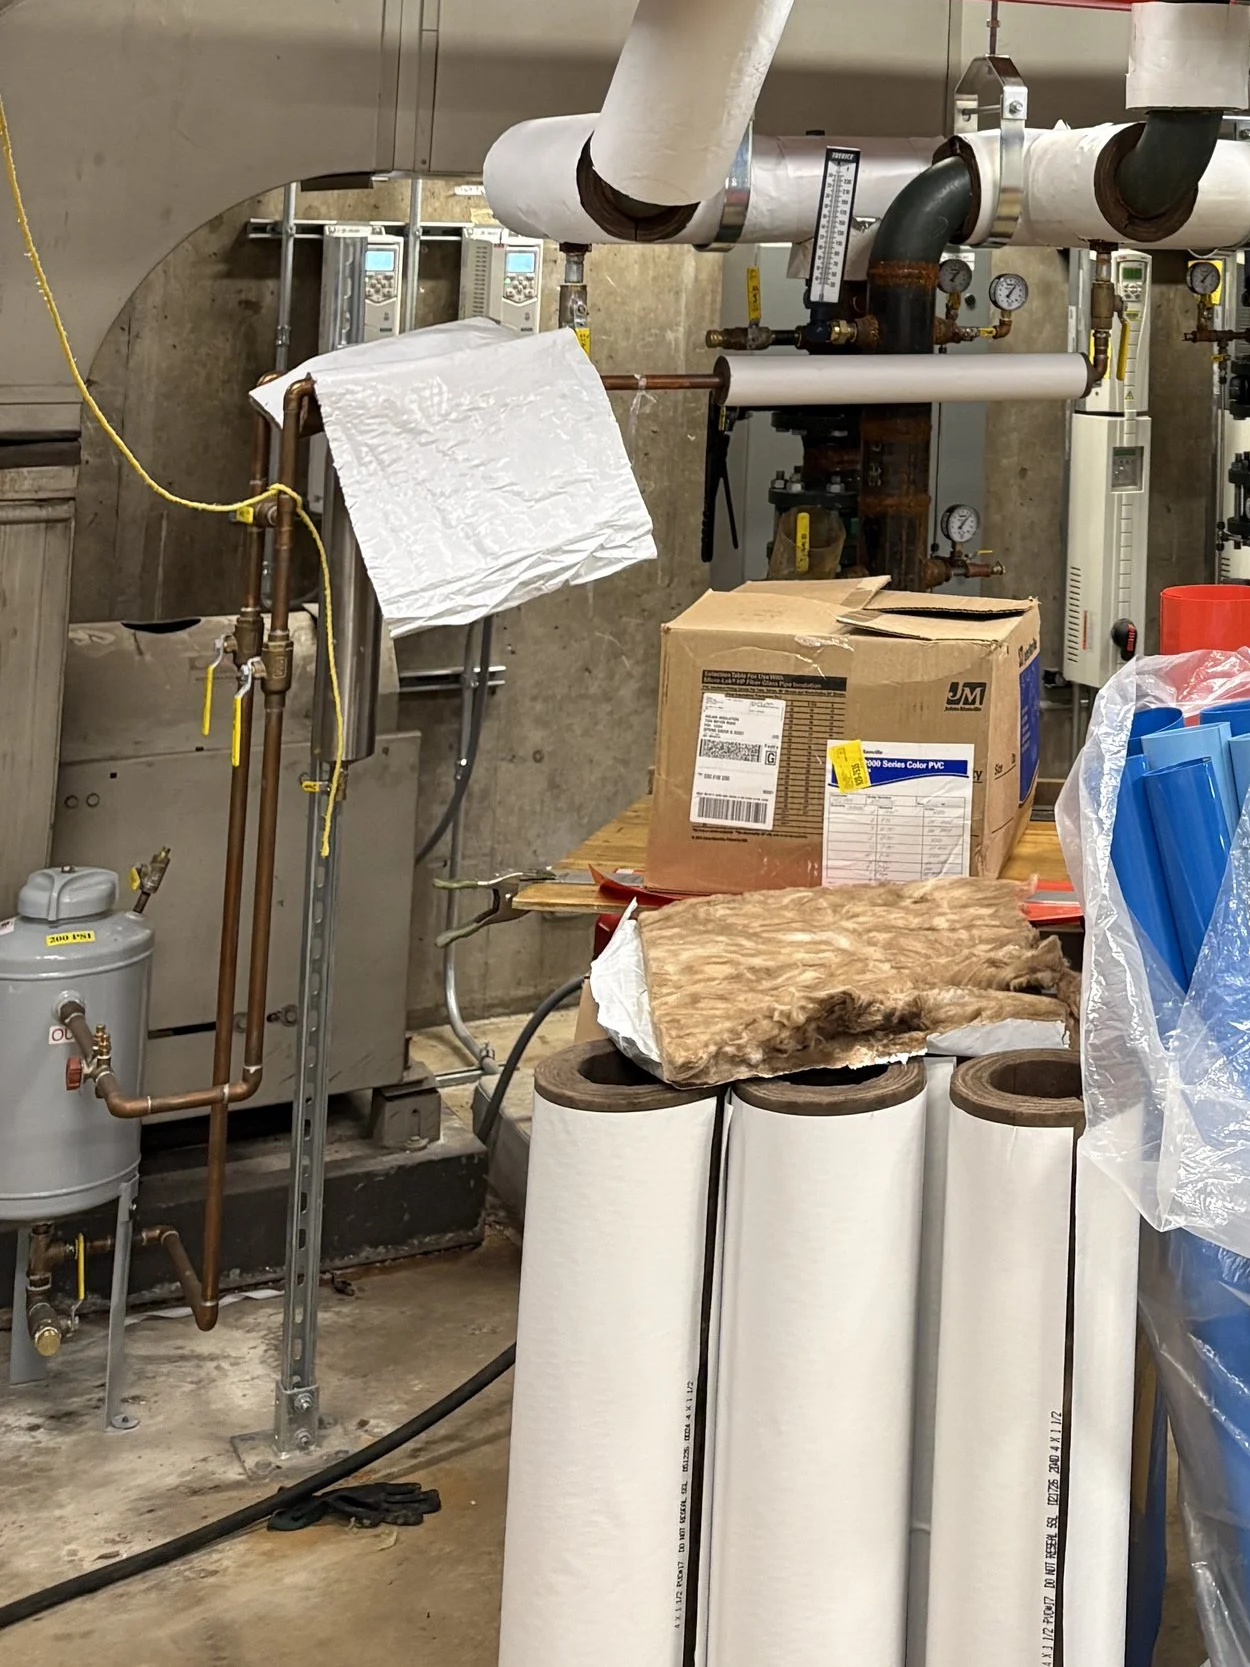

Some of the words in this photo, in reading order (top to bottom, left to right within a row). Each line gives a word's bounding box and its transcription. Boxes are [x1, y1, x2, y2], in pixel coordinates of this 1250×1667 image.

[947, 682, 986, 706] JM
[767, 752, 774, 763] G
[882, 760, 905, 768] Series
[906, 761, 927, 769] Color
[928, 761, 945, 769] PVC
[49, 935, 69, 943] 200
[72, 932, 92, 941] PSI
[1051, 1411, 1062, 1425] 1/2
[678, 1543, 685, 1552] DO
[686, 1381, 694, 1393] 1/2
[1046, 1515, 1058, 1529] SSL
[1045, 1533, 1057, 1559] RESEAL
[1045, 1561, 1056, 1575] NOT
[1044, 1578, 1055, 1588] DO
[1043, 1627, 1054, 1641] 1/2
